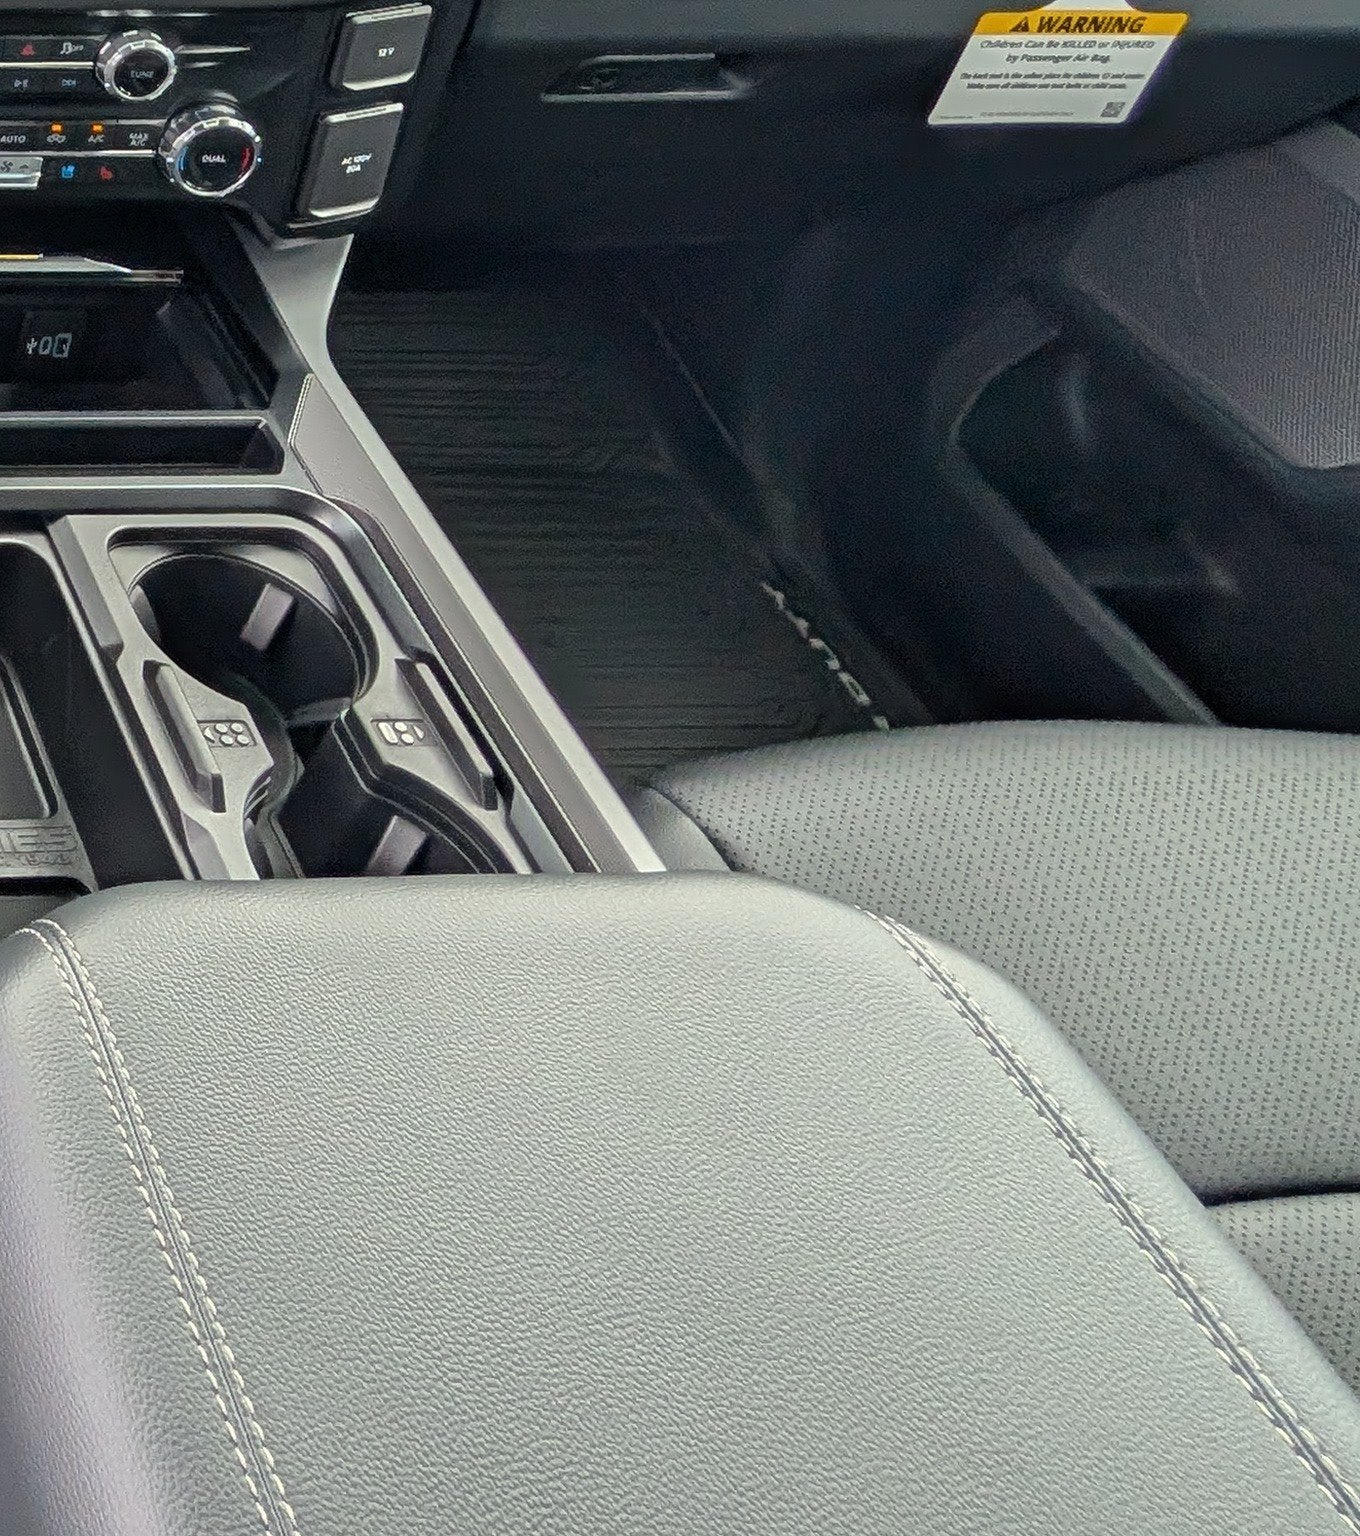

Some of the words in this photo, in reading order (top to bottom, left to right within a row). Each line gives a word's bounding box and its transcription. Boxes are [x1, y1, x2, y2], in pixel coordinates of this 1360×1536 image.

[1036, 16, 1147, 34] WARNING
[0, 134, 26, 143] AUTO
[88, 134, 104, 143] A/C
[202, 154, 226, 163] DUAL
